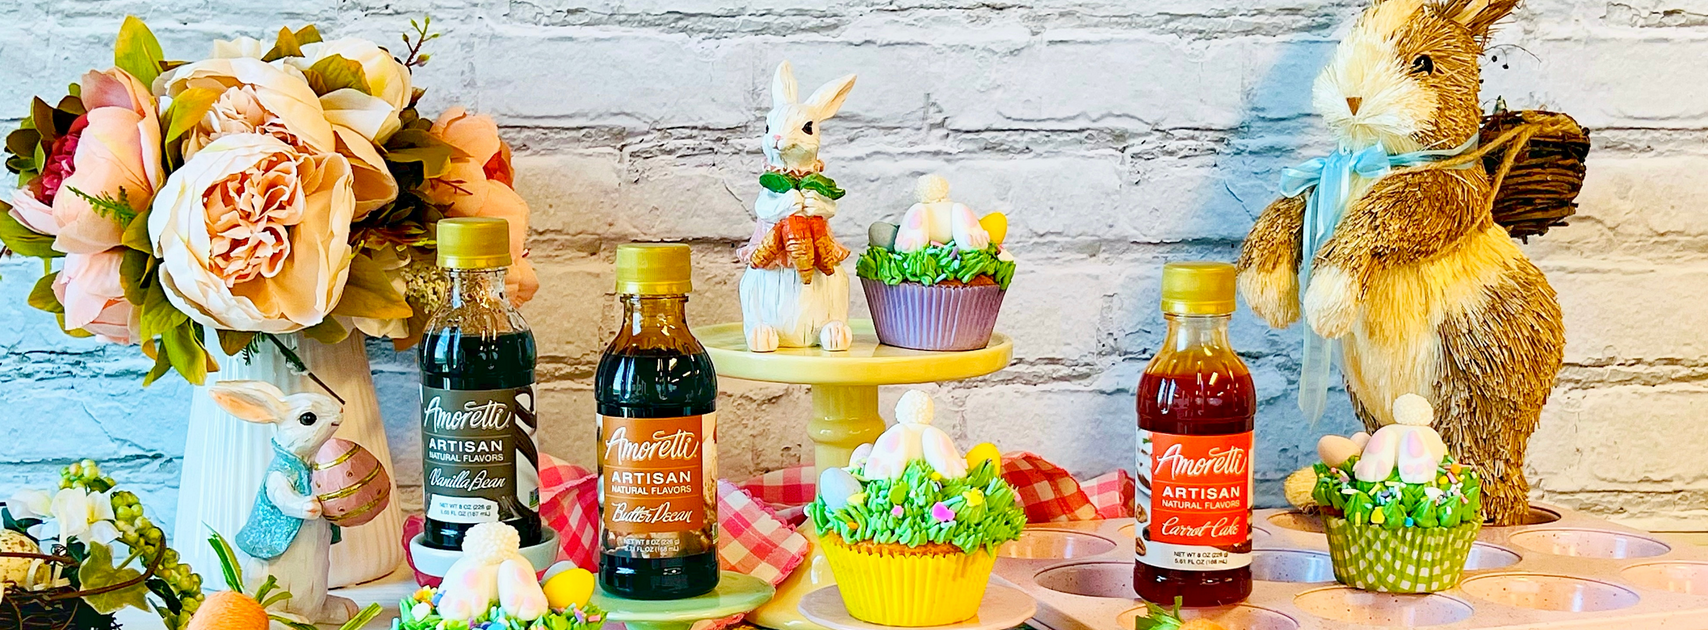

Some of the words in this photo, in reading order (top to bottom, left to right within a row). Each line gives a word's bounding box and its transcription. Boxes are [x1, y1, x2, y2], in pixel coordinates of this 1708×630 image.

[424, 396, 511, 432] Amoretti
[429, 438, 502, 452] ARTISAN
[604, 427, 699, 465] Amoretti
[429, 451, 460, 462] NATURAL
[463, 454, 503, 462] FLAVORS
[1154, 444, 1247, 480] Amoretti
[429, 468, 470, 488] Vanilla
[467, 470, 506, 491] Bean
[611, 471, 690, 484] ARTISAN
[611, 485, 648, 495] NATURAL
[651, 486, 691, 494] FLAVORS
[1162, 486, 1240, 499] ARTISAN
[611, 502, 651, 522] Butter
[649, 502, 693, 524] Pecan
[1162, 500, 1201, 509] NATURAL
[1205, 500, 1240, 509] FLAVORS
[1161, 517, 1211, 537] Carrot
[1208, 517, 1240, 537] Cake
